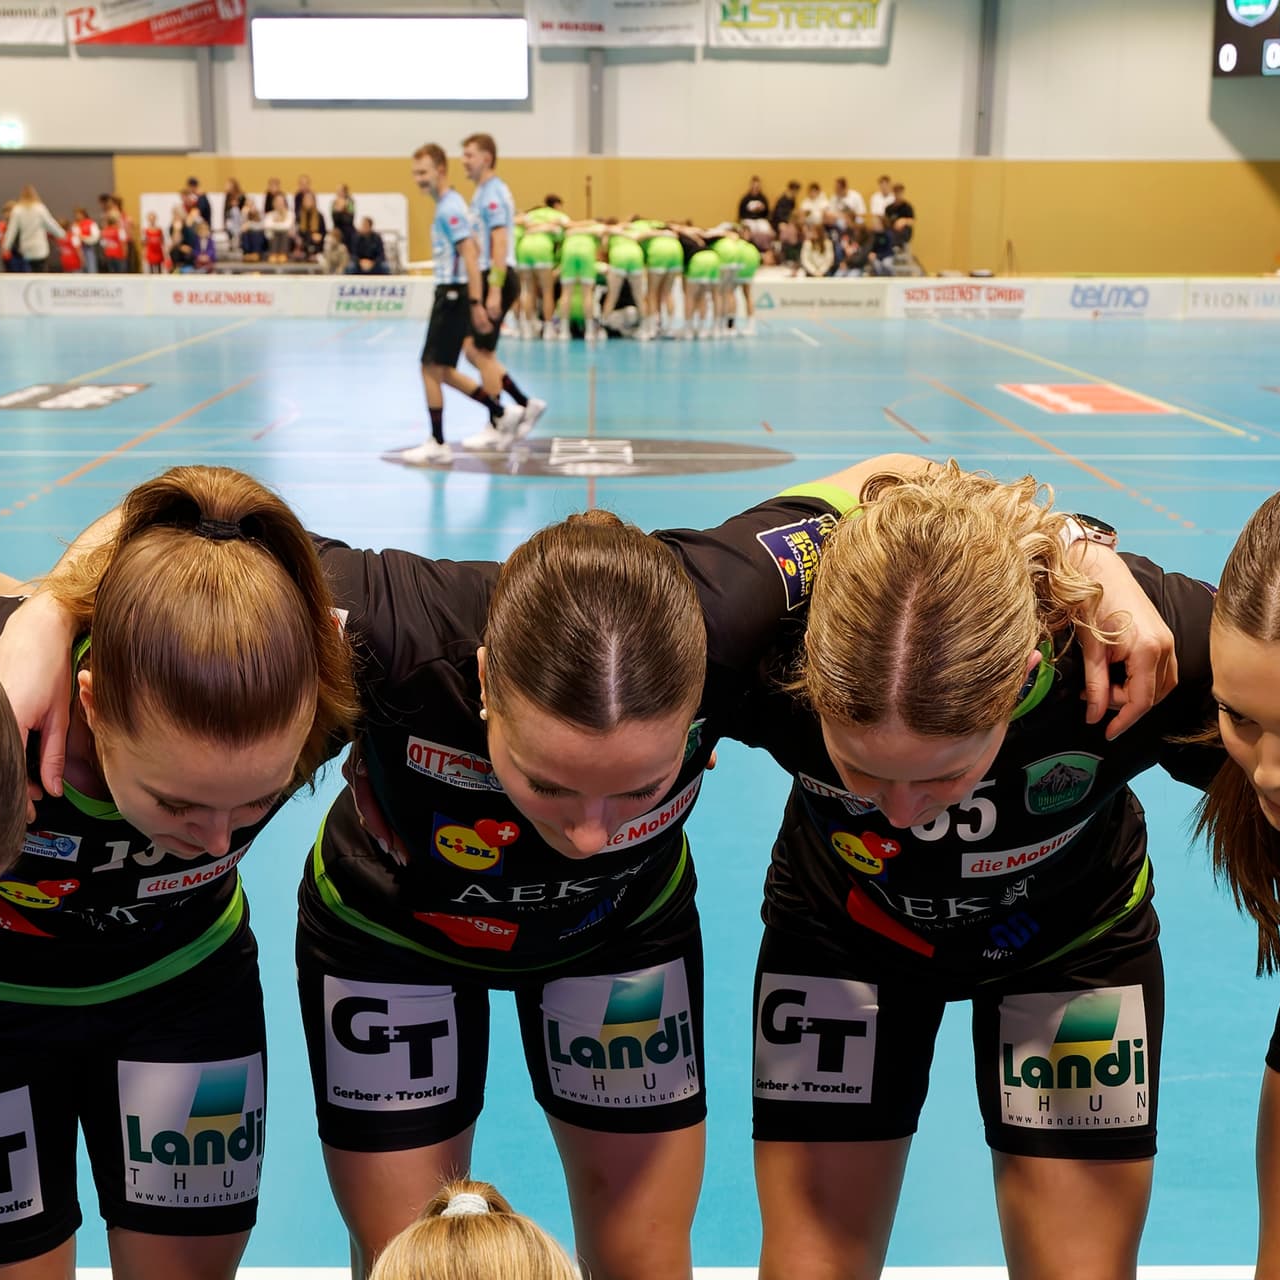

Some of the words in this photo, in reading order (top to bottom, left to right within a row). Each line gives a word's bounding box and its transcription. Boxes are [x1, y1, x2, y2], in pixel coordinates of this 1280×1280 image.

[970, 858, 1003, 873] die
[147, 879, 178, 893] die
[450, 874, 610, 905] AEK
[546, 1010, 694, 1070] Landi
[1003, 1037, 1144, 1090] Landi
[332, 1084, 381, 1102] Gerber
[395, 1083, 451, 1102] Troxler
[756, 1077, 789, 1093] Gerber
[801, 1080, 862, 1095] Troxler
[1004, 1090, 1147, 1112] THUN
[1008, 1112, 1143, 1127] www.landithun.ch
[126, 1106, 263, 1166] Landi
